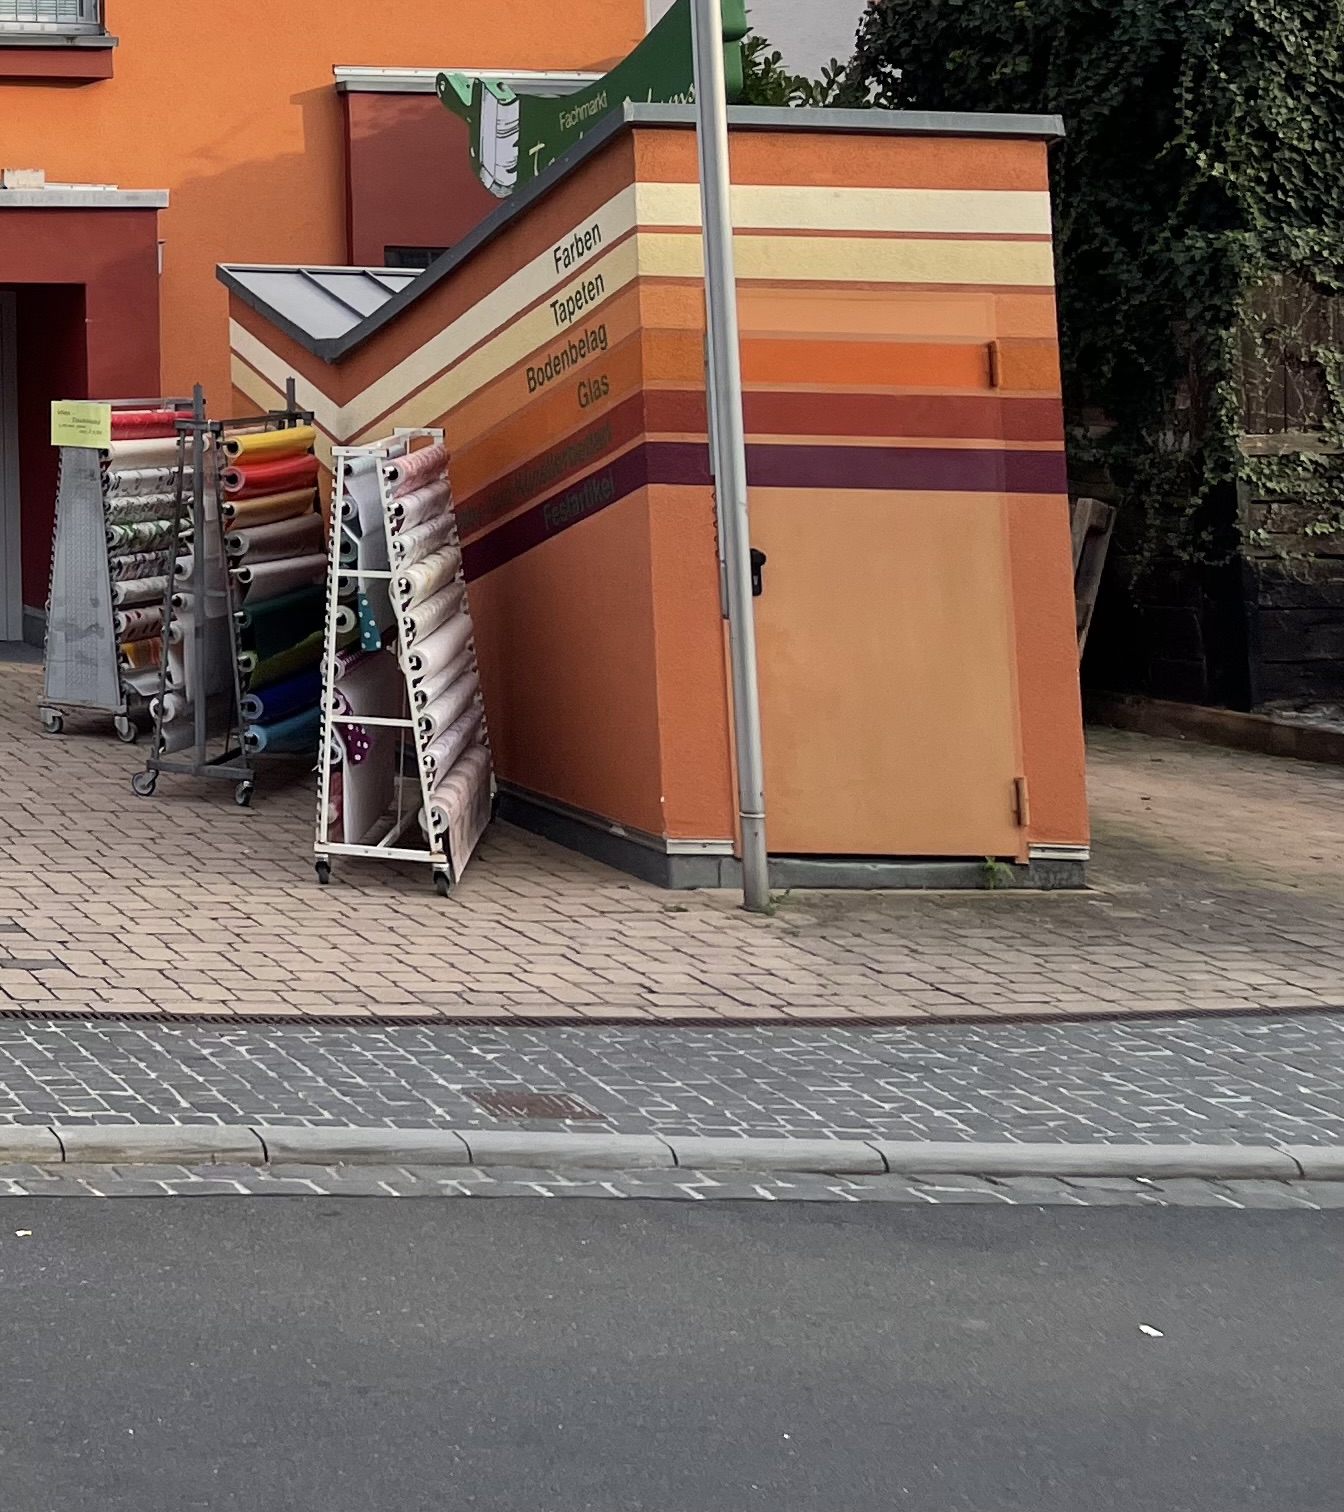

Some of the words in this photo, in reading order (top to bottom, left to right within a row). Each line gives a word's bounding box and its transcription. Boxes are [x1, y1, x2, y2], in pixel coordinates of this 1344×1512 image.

[559, 89, 608, 131] Fachmarkt
[553, 223, 602, 275] Farben
[550, 273, 605, 326] Tapeten
[526, 323, 608, 394] Bodenbelag
[577, 375, 610, 408] Glas
